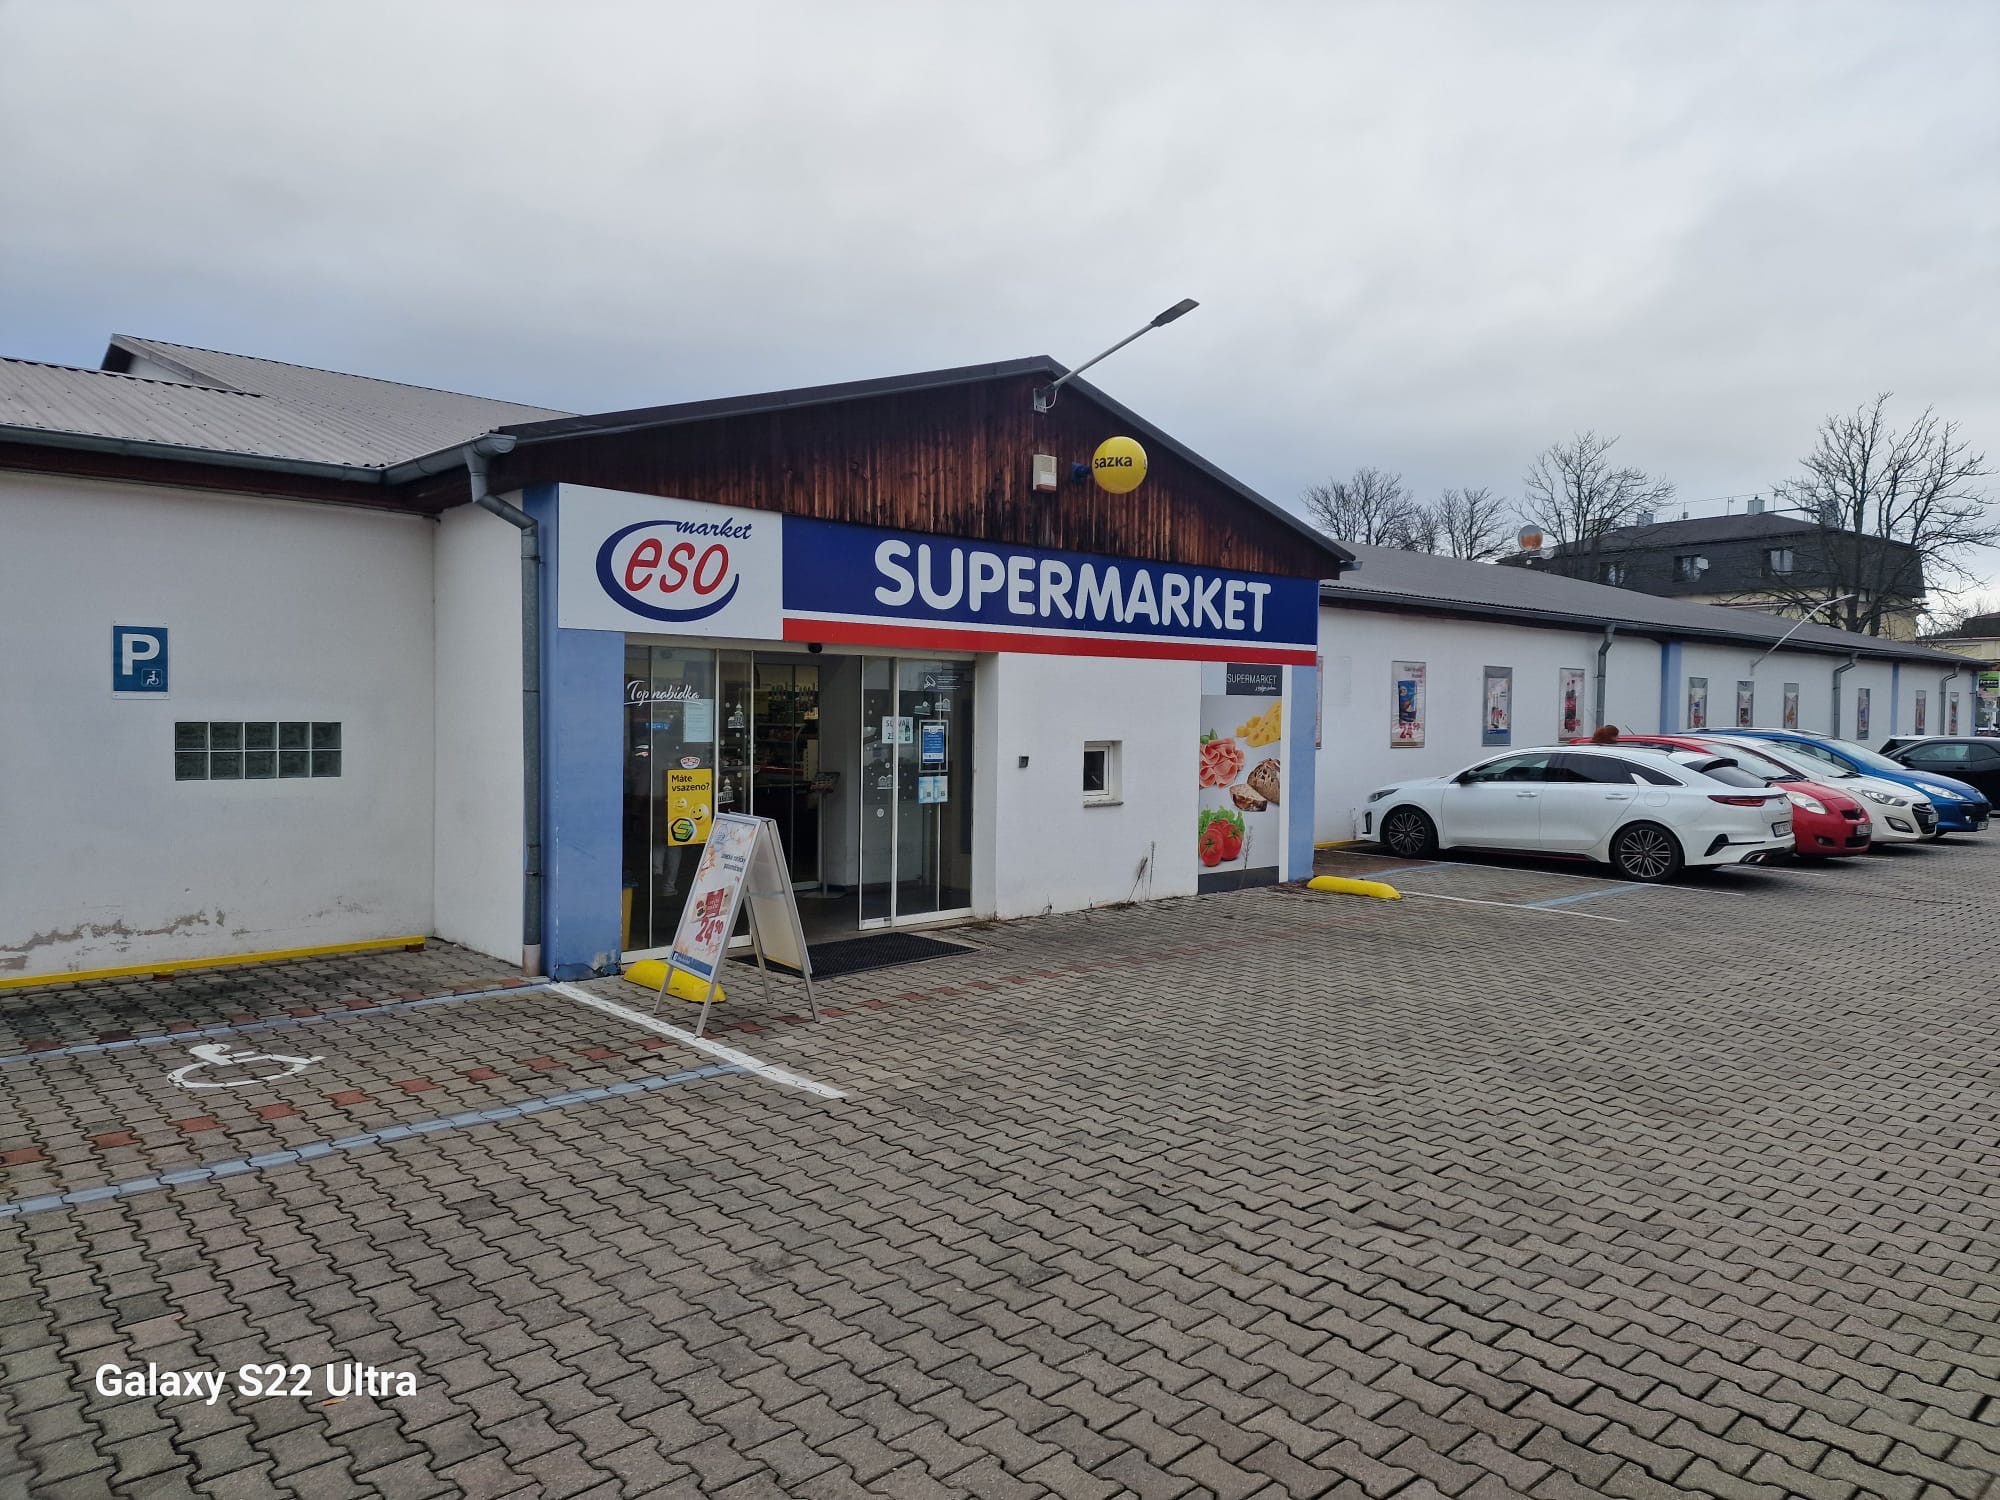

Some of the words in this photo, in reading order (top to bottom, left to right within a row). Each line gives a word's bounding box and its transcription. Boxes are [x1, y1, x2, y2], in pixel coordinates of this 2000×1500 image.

[676, 517, 752, 539] market
[624, 537, 730, 596] eso
[874, 539, 1272, 633] SUPERMARKET
[122, 633, 160, 676] P
[1226, 673, 1278, 685] SUPERMARKET
[627, 680, 649, 707] Top
[671, 774, 693, 783] Máte
[672, 782, 710, 792] vsazeno?
